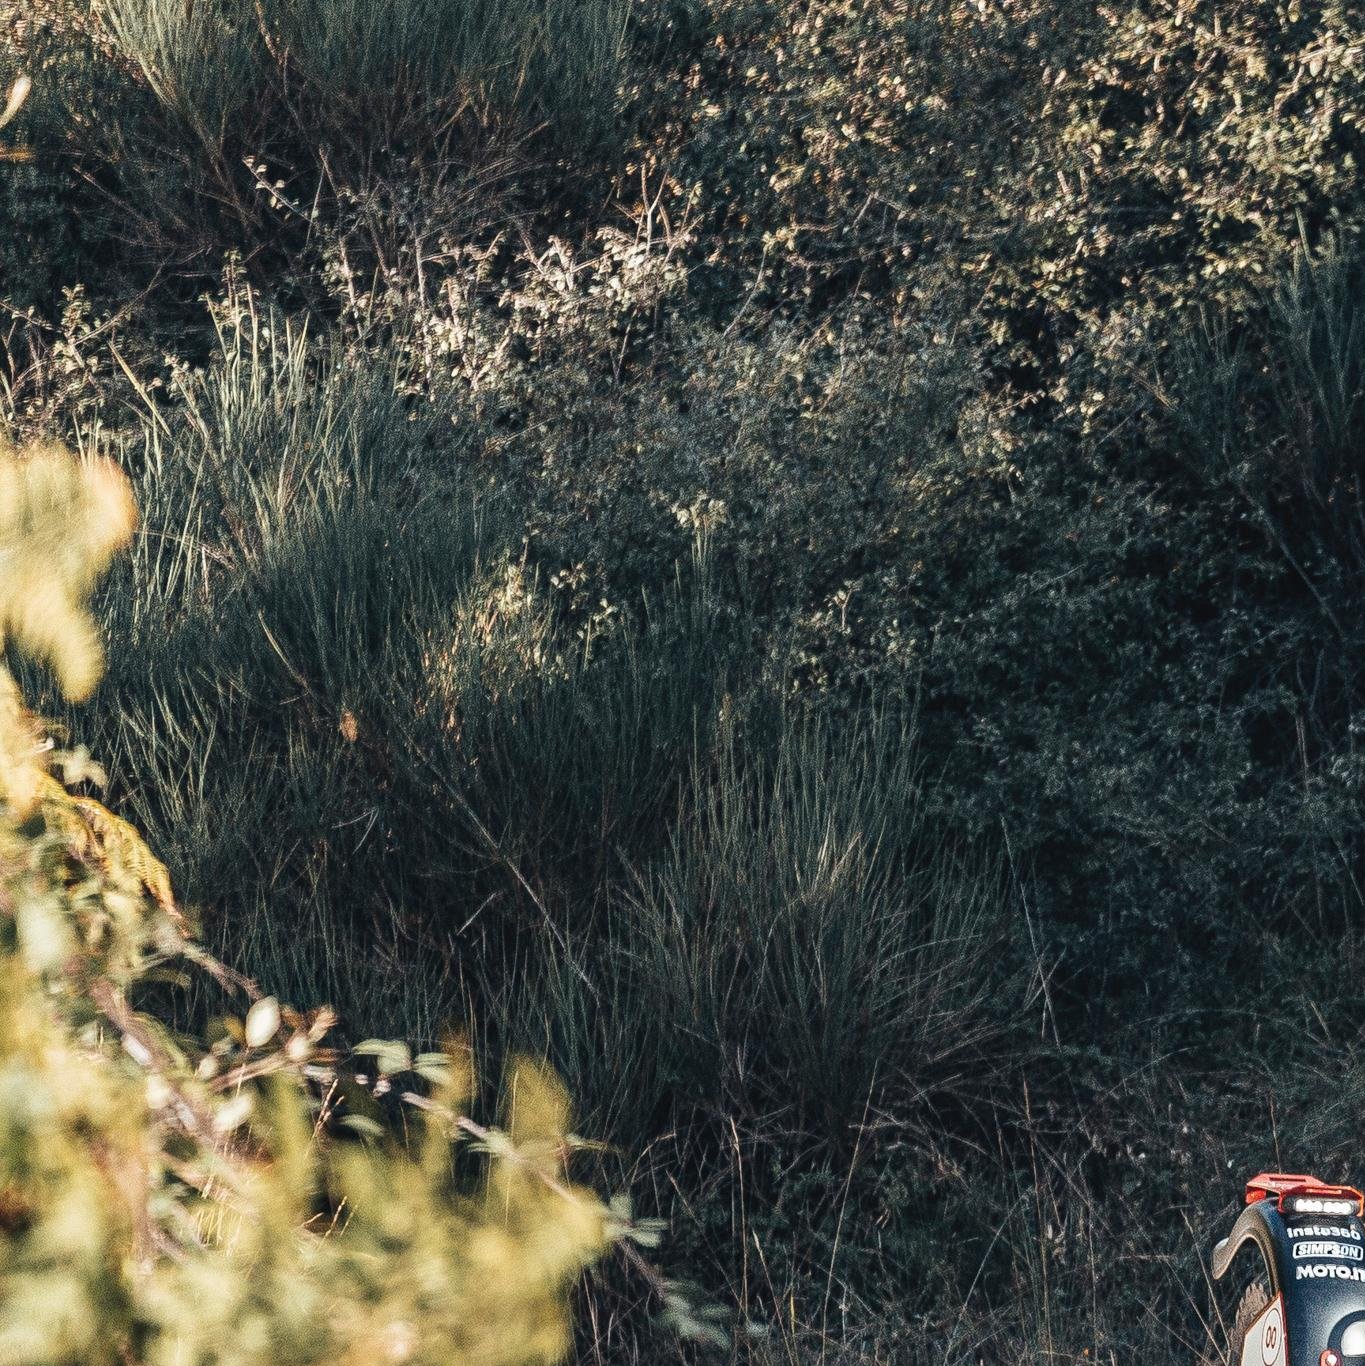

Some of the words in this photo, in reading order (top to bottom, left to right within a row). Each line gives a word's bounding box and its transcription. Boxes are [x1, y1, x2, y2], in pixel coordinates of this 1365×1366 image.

[1286, 1225, 1361, 1240] Insta360
[1297, 1243, 1359, 1258] SIMPSON
[1265, 1325, 1277, 1349] 00
